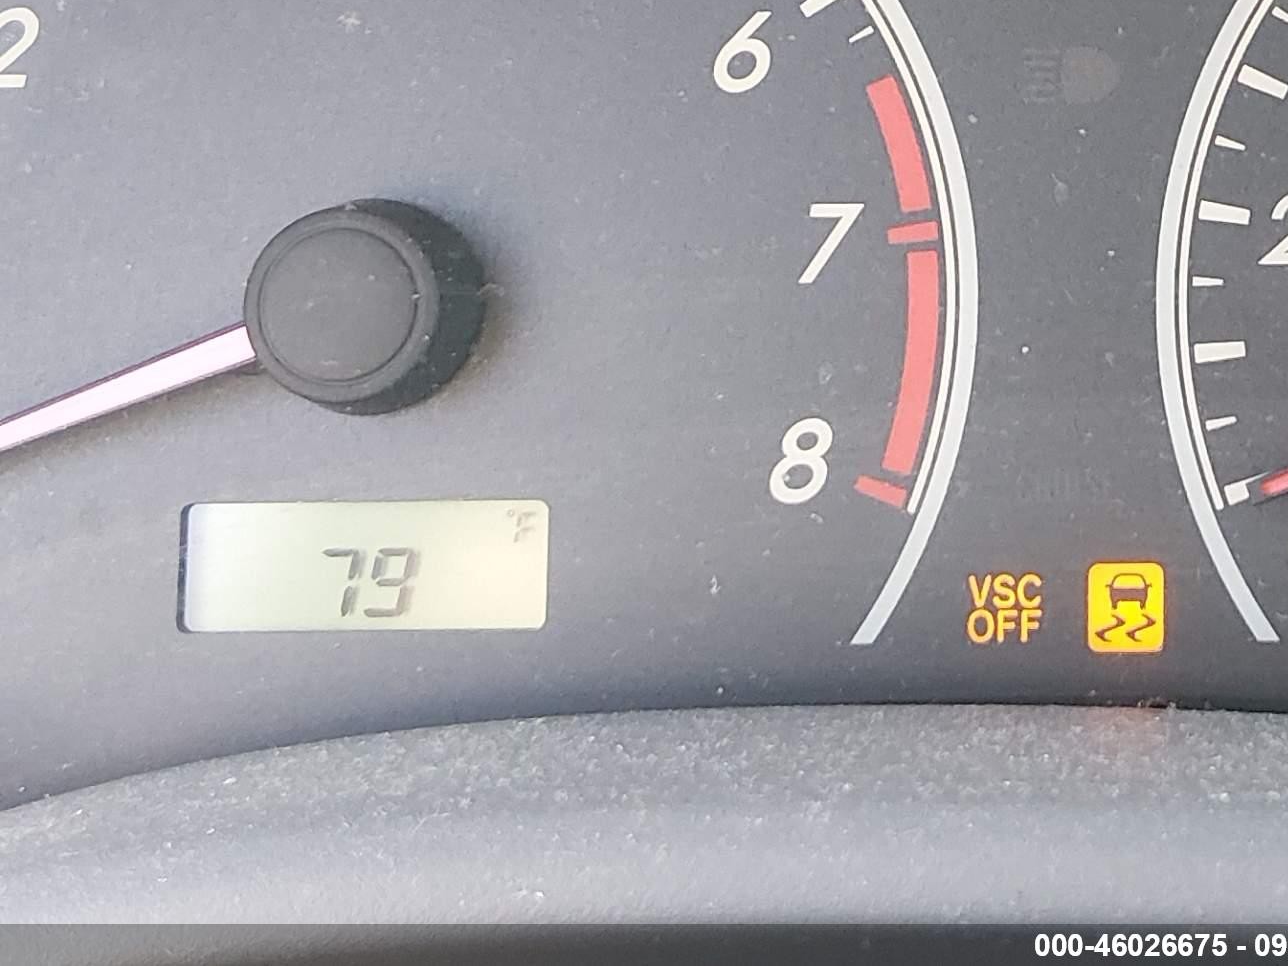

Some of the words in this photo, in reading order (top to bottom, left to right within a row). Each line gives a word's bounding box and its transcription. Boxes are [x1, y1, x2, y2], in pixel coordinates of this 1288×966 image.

[0, 8, 39, 88] 2
[714, 12, 771, 93] 6
[799, 204, 864, 283] 7
[770, 418, 832, 503] 8
[322, 548, 419, 618] 79
[968, 574, 1043, 609] VSC
[966, 609, 1043, 644] OFF
